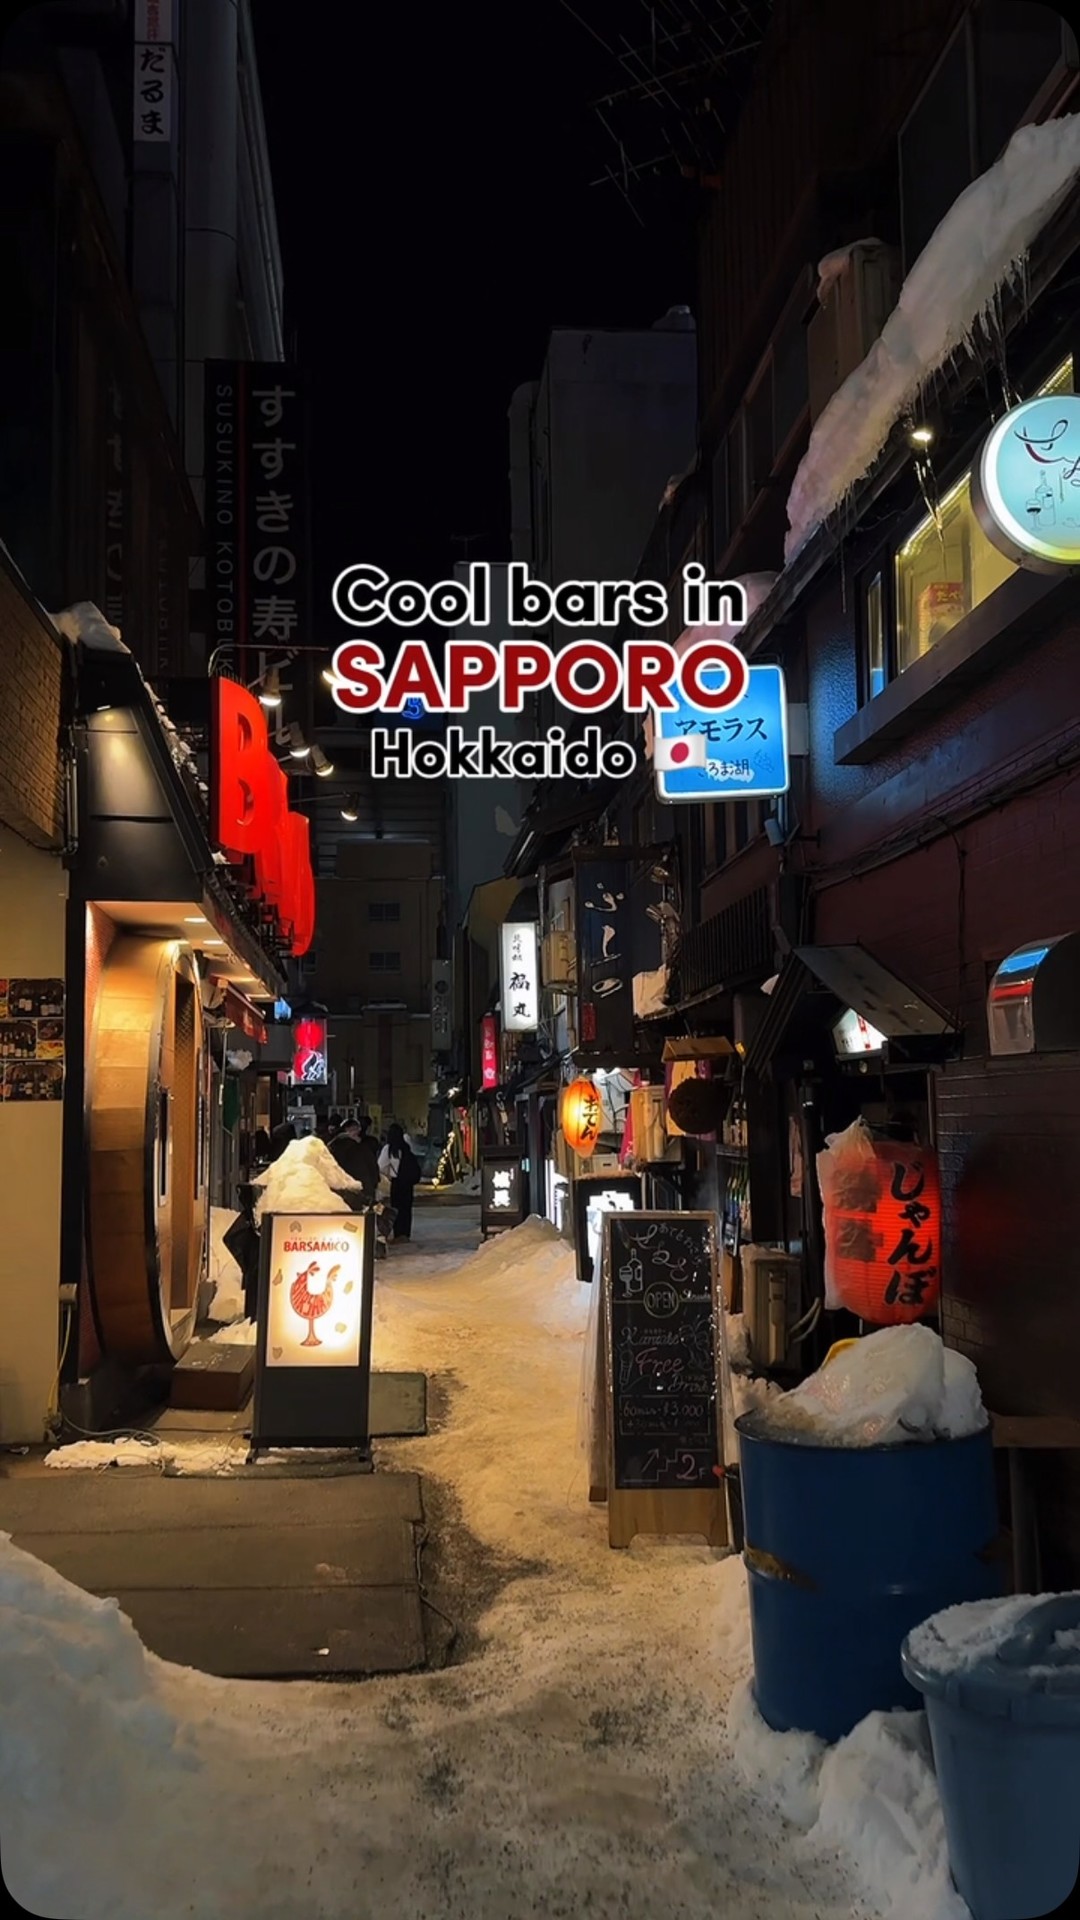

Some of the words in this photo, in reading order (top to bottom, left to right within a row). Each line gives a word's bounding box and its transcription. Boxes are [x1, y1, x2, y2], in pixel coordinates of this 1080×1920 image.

[141, 47, 165, 134] だるま
[216, 384, 233, 526] SUSUKINO
[675, 717, 768, 742] アモラス
[283, 1241, 350, 1253] BARSAMICO
[884, 1161, 937, 1305] じゃんぼ
[647, 1291, 676, 1309] OPEN
[635, 1346, 685, 1376] Free
